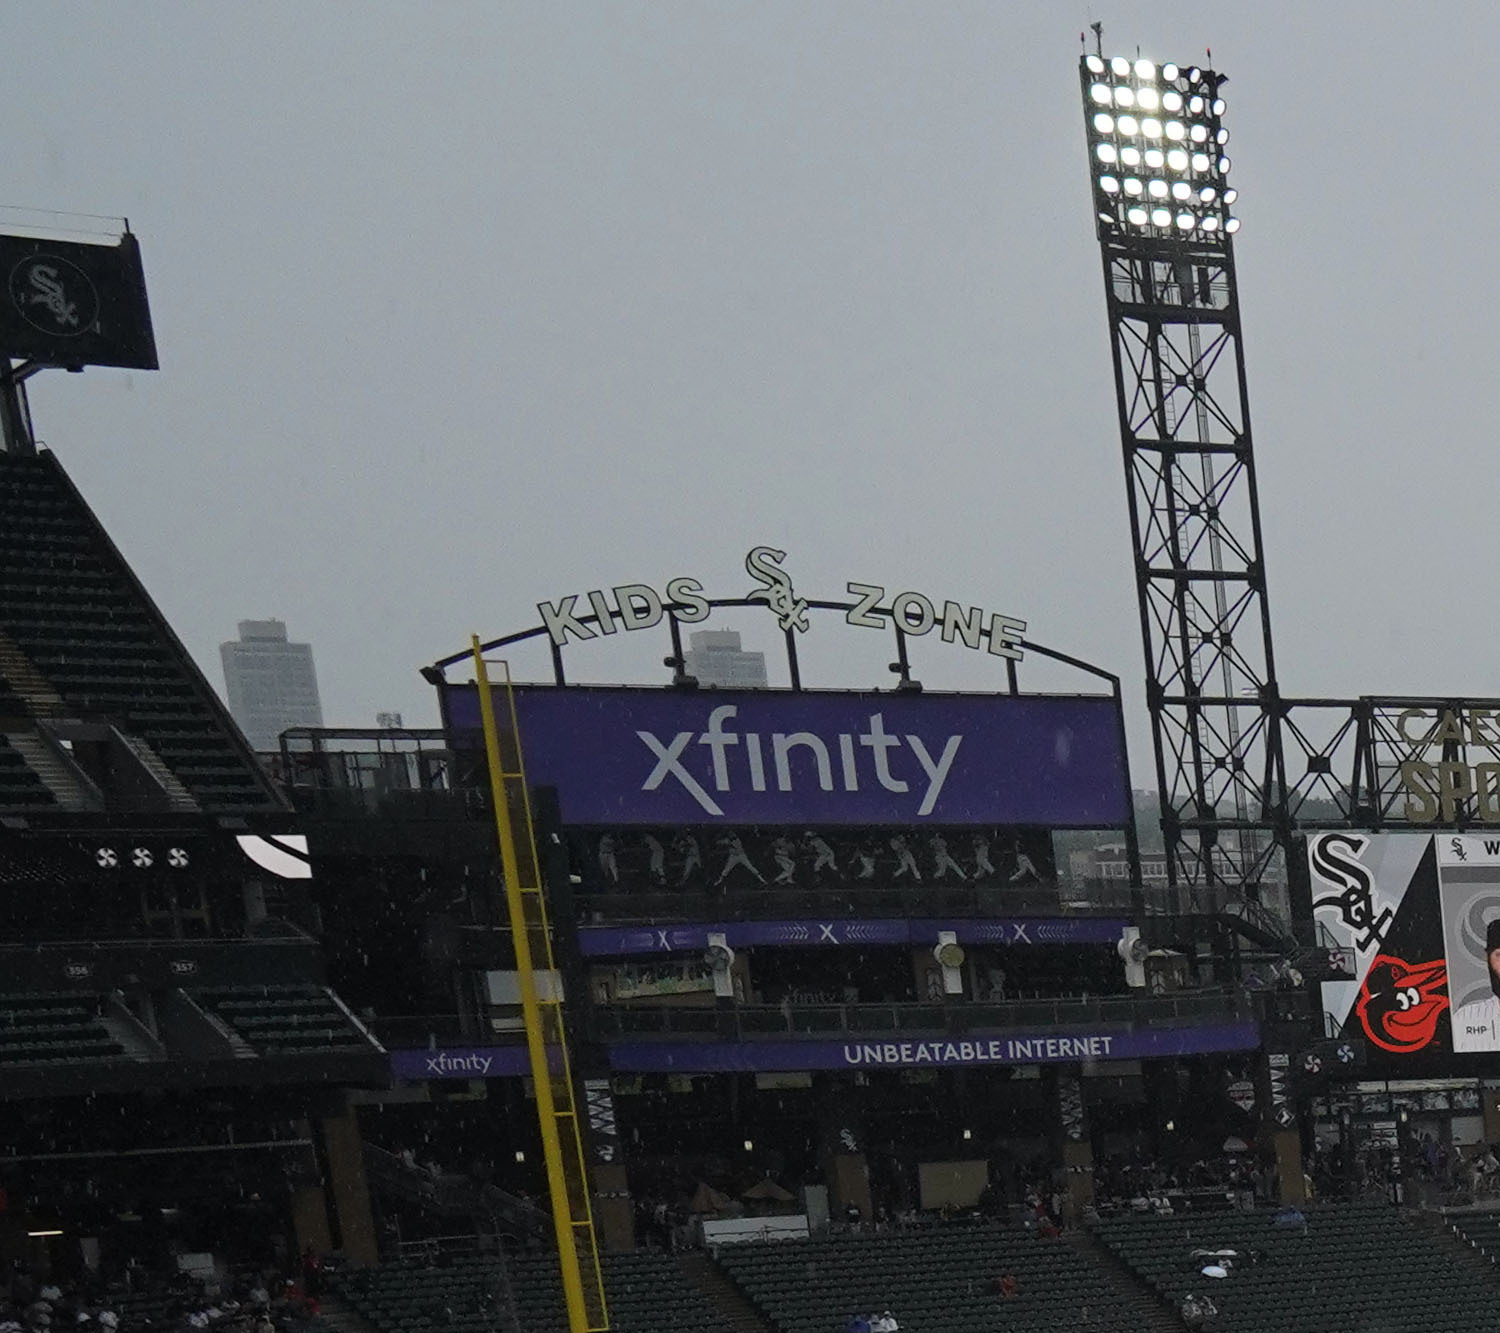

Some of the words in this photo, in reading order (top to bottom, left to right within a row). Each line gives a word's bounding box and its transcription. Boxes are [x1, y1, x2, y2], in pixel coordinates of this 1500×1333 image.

[538, 577, 710, 646] KIDS
[846, 581, 1028, 661] ZONE
[640, 704, 964, 815] xfinity
[844, 1037, 1001, 1065] UNBEATABLE
[1008, 1035, 1112, 1059] INTERNET
